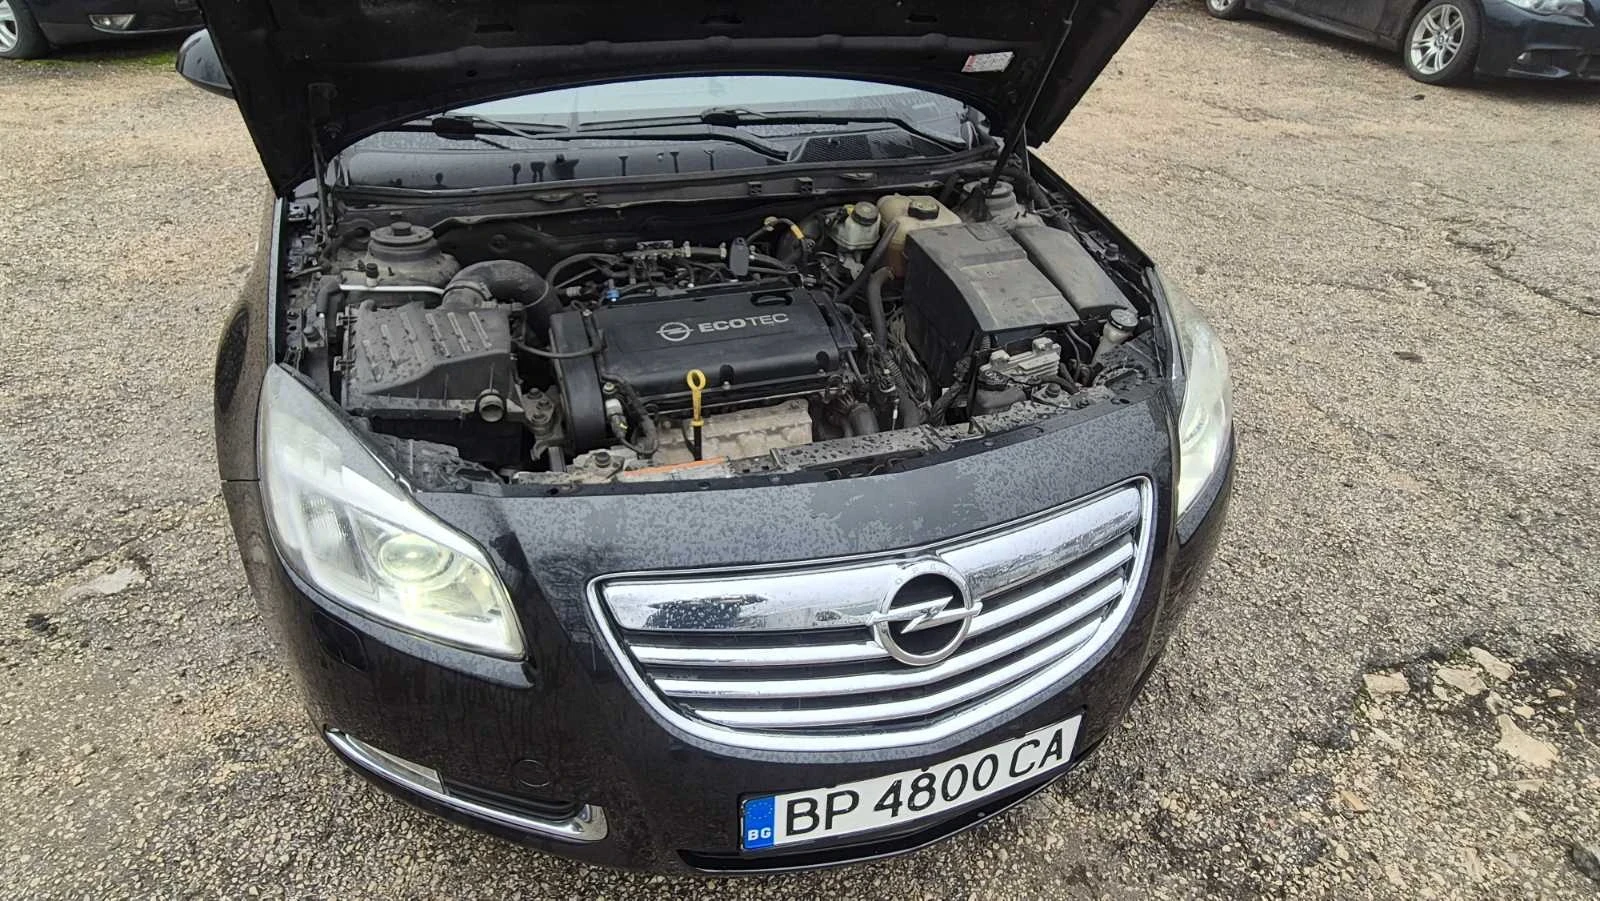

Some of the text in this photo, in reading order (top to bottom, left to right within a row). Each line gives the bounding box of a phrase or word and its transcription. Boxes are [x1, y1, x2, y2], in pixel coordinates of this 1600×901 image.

[698, 313, 789, 333] ECOTEC
[785, 728, 1064, 837] BP 4800 CA
[747, 827, 772, 841] BG
